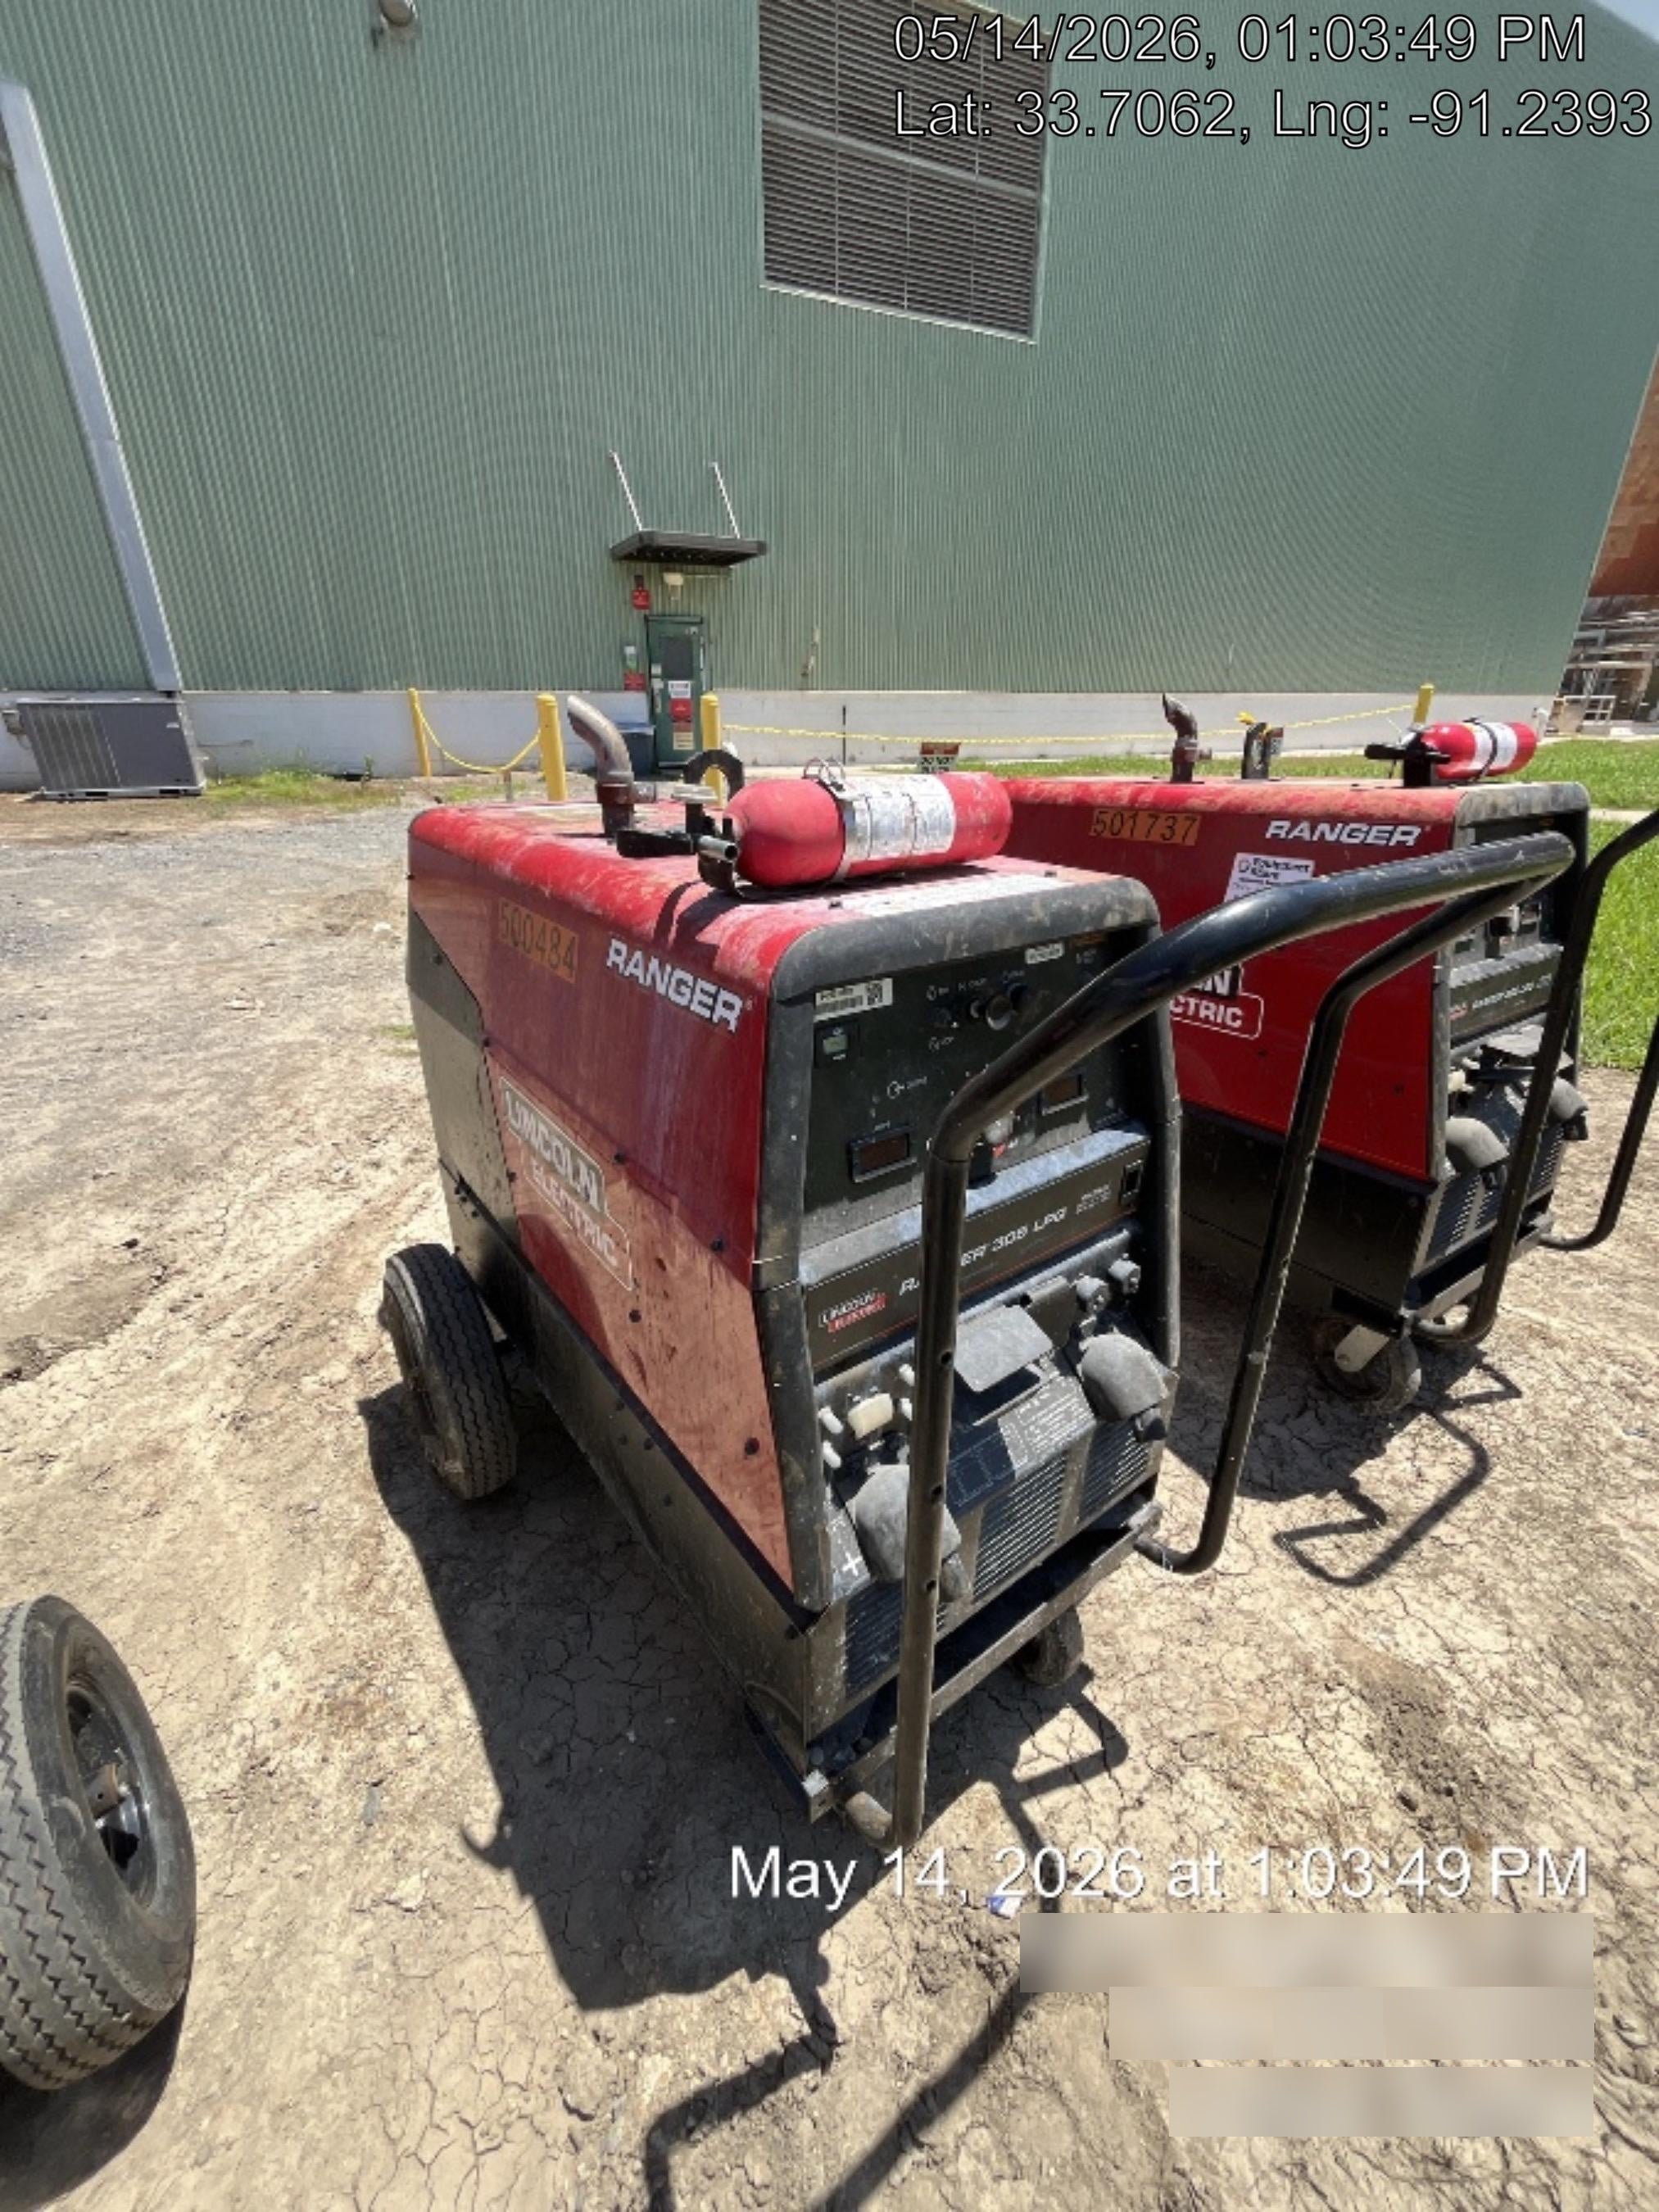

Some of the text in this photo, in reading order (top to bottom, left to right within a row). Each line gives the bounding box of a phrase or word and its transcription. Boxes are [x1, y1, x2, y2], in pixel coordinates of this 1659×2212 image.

[1093, 810, 1198, 844] 501737
[1266, 819, 1421, 847] RANGER
[501, 900, 577, 972] 500484
[606, 938, 744, 1034] RANGER
[505, 1090, 601, 1213] LINCOLN
[531, 1160, 619, 1268] ELECTRIC
